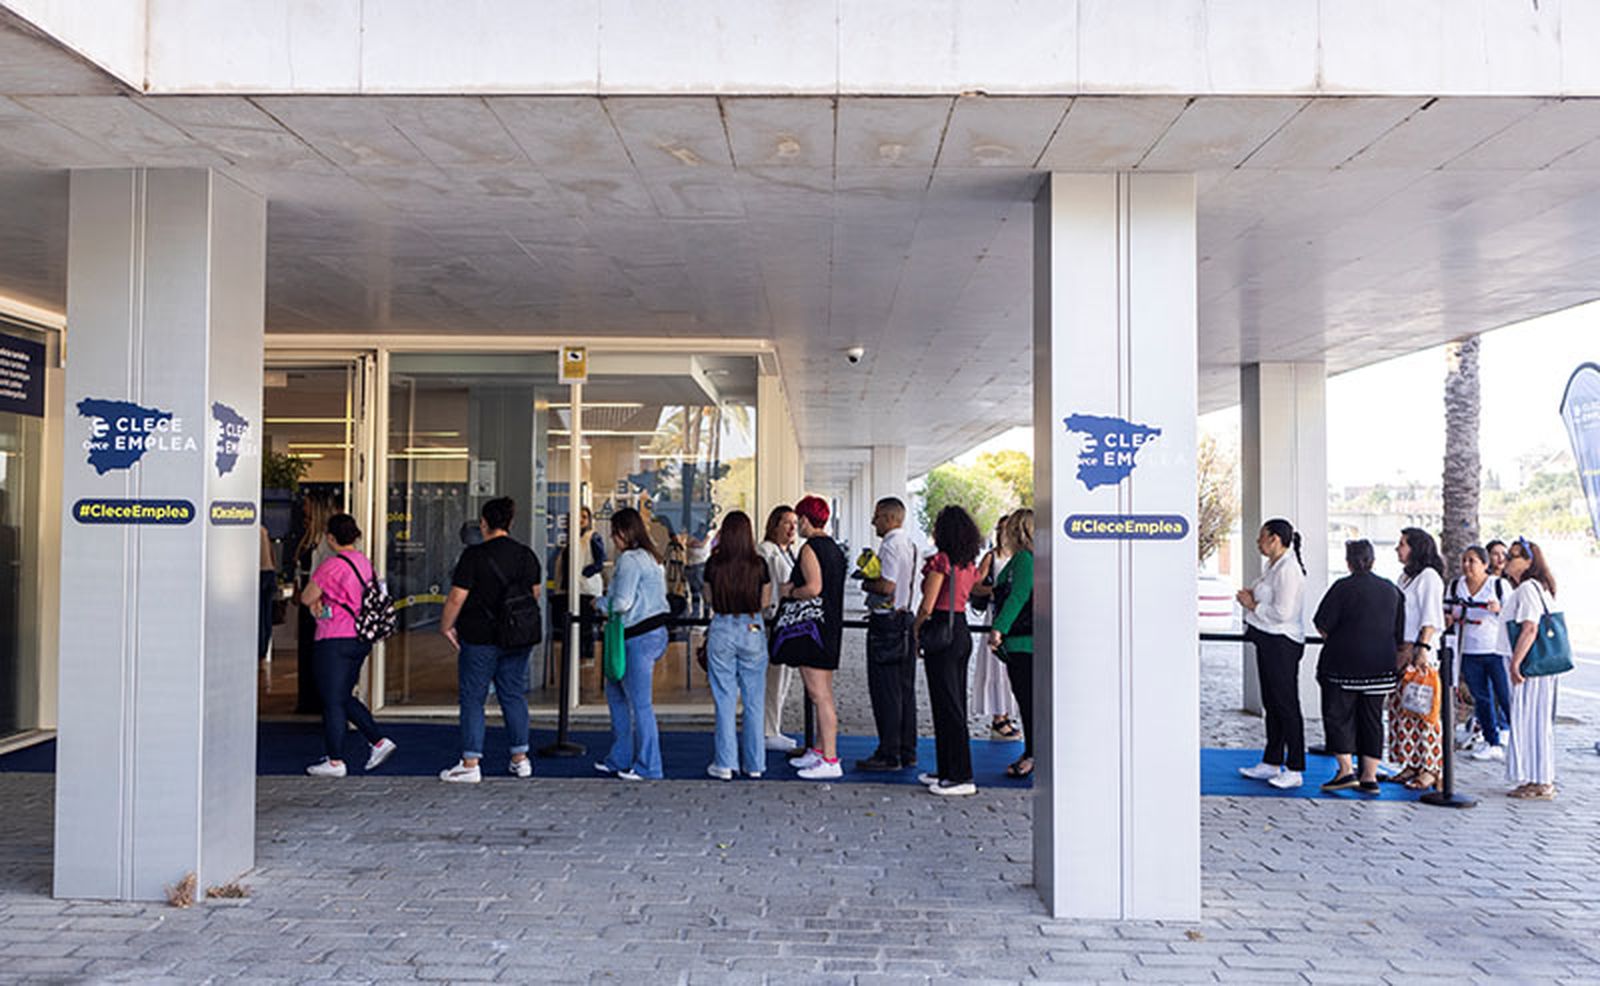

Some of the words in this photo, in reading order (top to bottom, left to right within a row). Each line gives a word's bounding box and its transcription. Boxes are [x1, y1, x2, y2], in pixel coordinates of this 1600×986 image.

[116, 417, 183, 433] CLECE
[114, 435, 197, 452] EMPLEA
[79, 503, 189, 522] #CleceEmplea
[1070, 519, 1184, 537] #CleceEmplea
